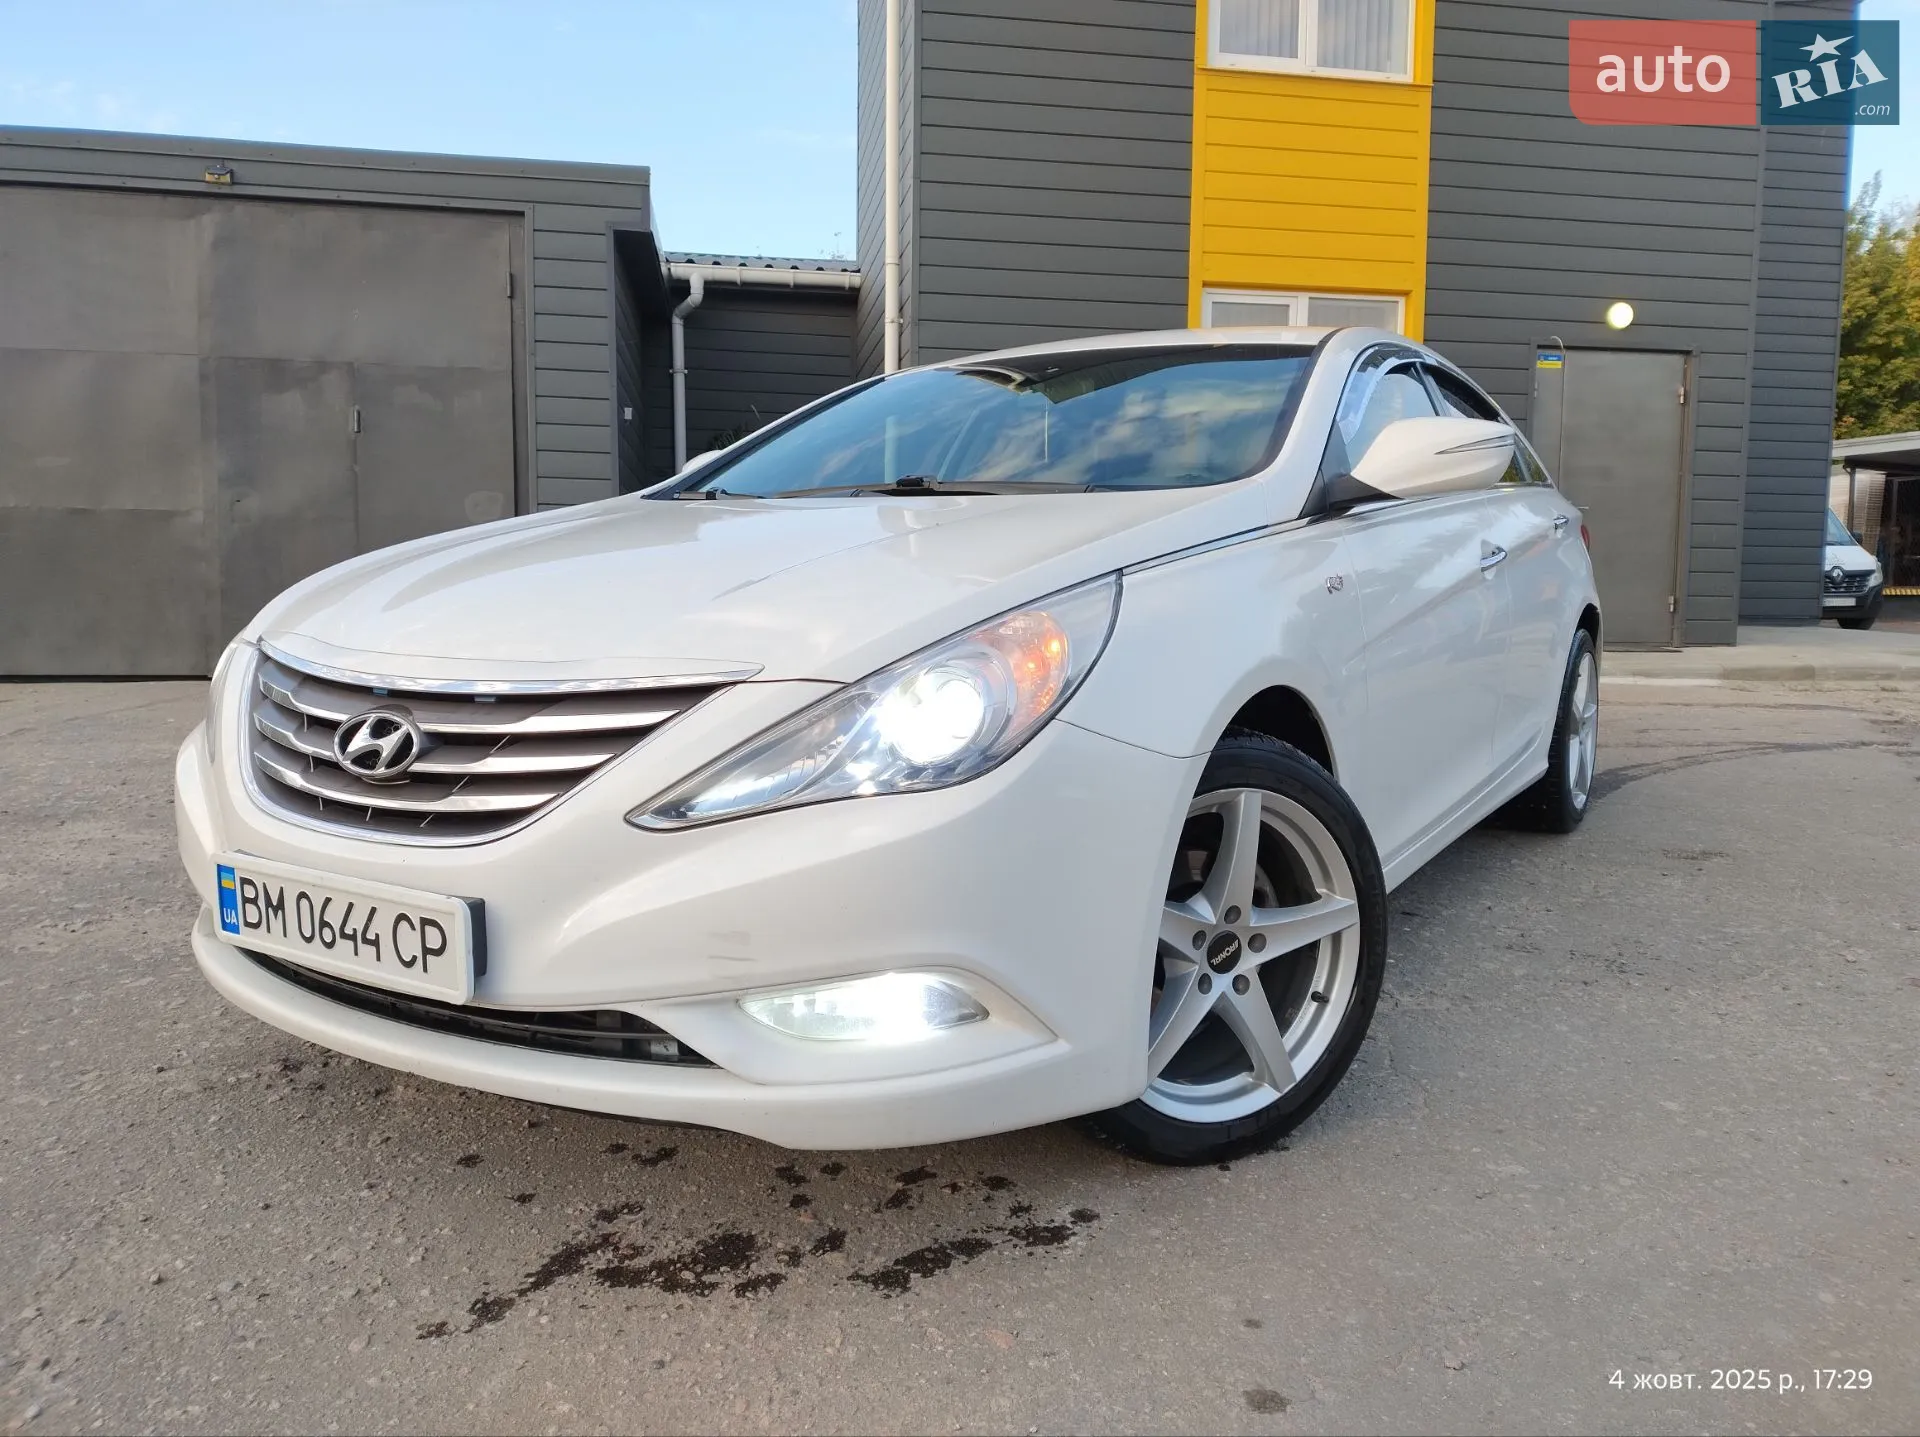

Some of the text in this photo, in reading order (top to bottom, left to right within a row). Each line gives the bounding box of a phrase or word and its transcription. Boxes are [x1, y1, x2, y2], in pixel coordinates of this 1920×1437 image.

[223, 907, 238, 926] UA
[239, 876, 447, 973] BM 0644 CP
